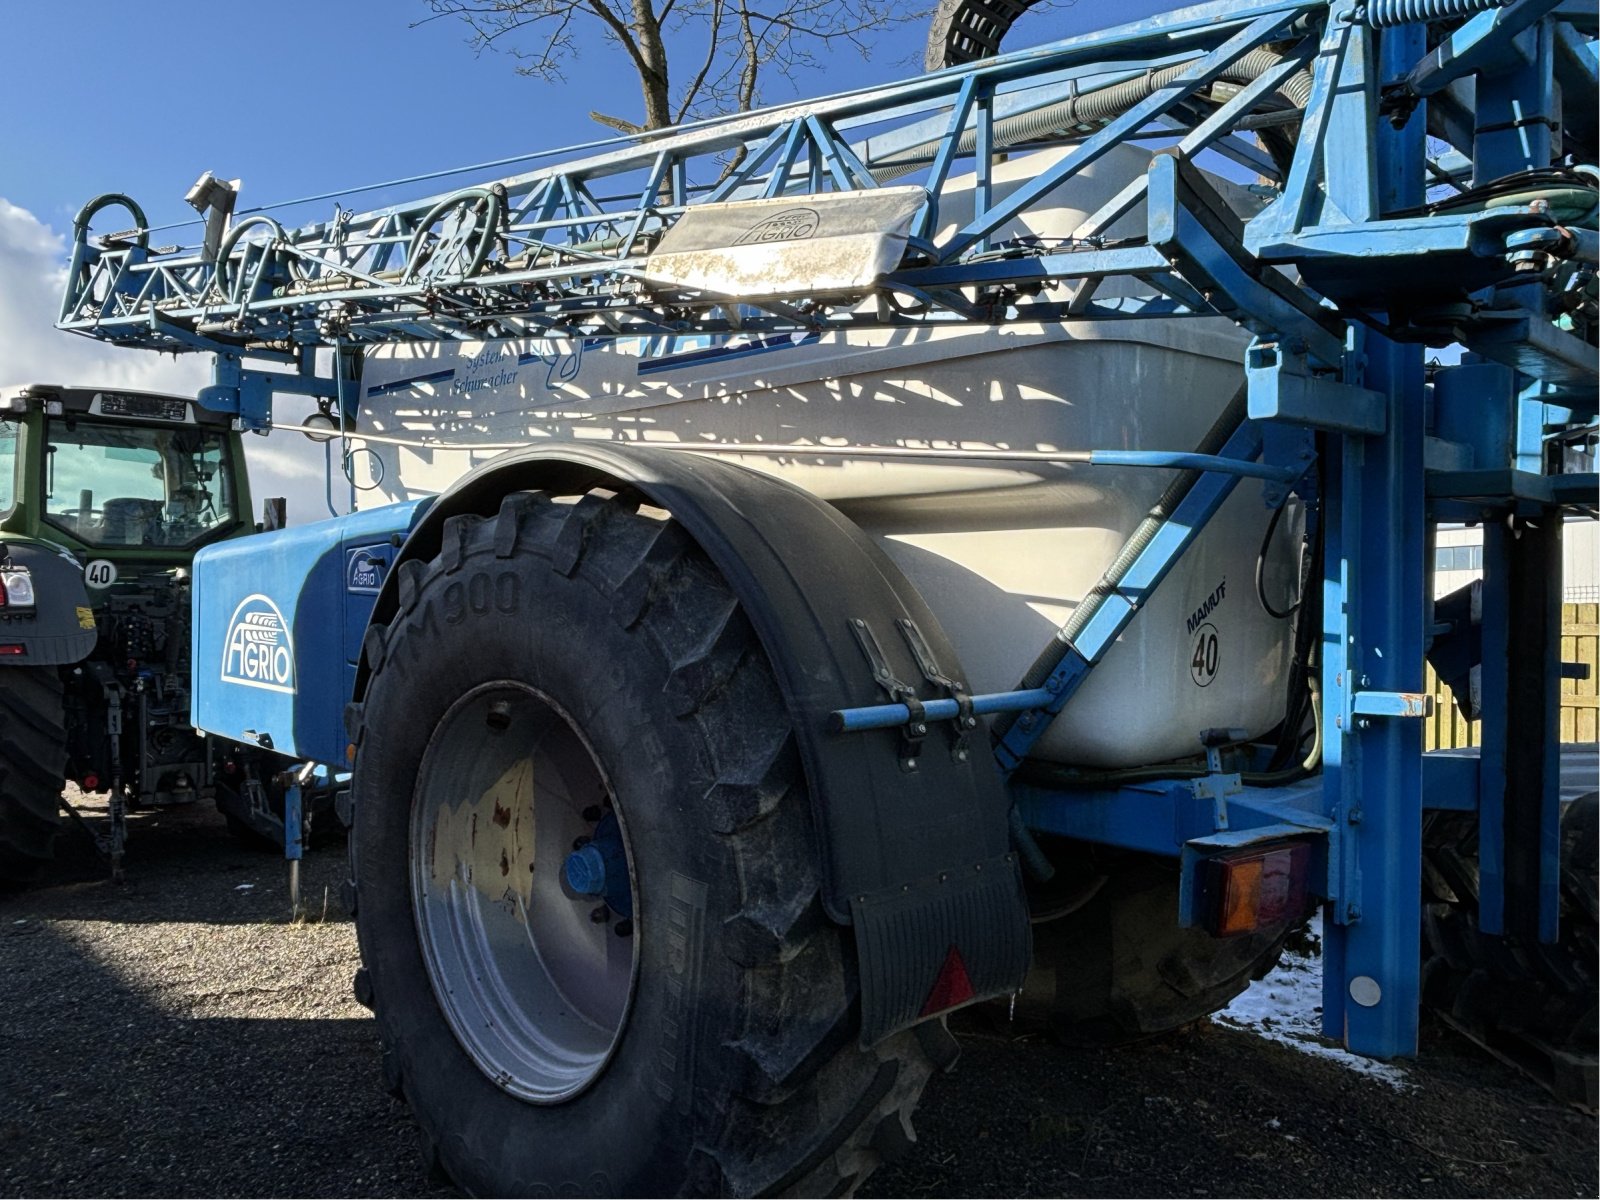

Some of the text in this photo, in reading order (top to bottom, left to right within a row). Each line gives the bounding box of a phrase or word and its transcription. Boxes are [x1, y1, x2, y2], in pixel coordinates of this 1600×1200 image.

[740, 220, 812, 242] AGRIO
[466, 348, 505, 374] System
[453, 369, 518, 395] Schumacher
[89, 565, 110, 584] 40
[352, 567, 375, 585] AGRIO
[1186, 580, 1226, 635] MAMUT
[227, 623, 290, 683] AGRIO
[1192, 633, 1218, 677] 40
